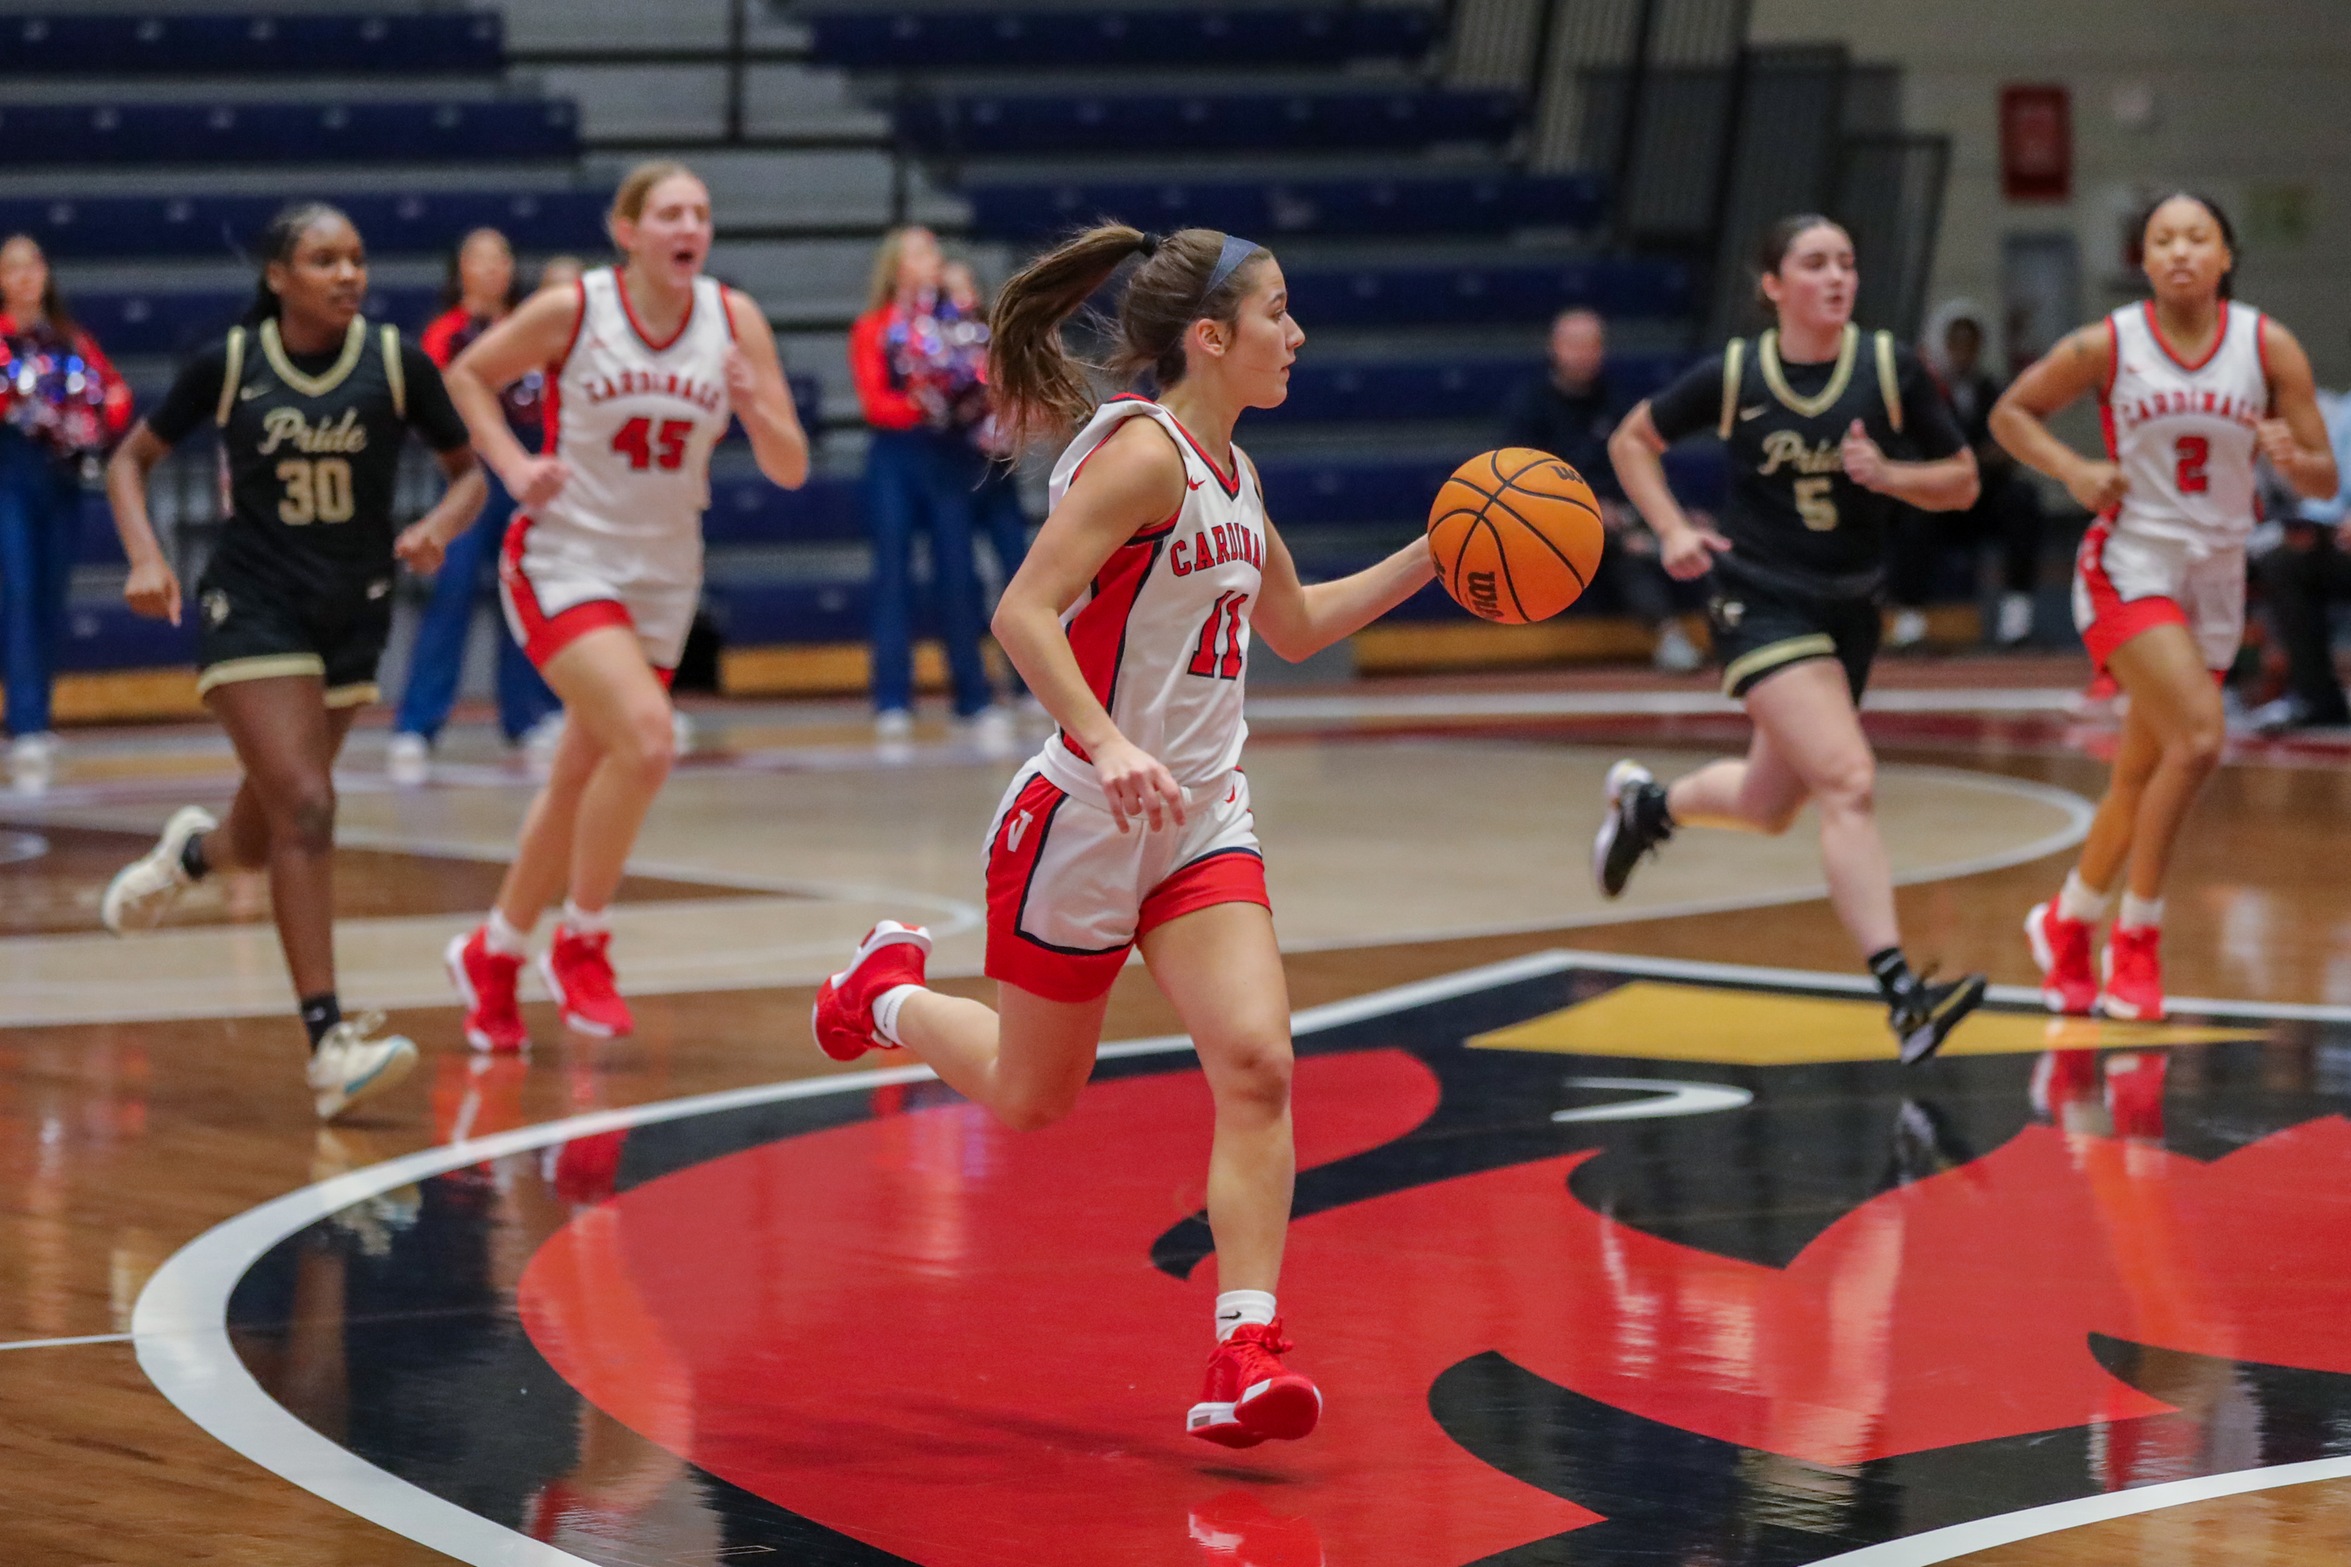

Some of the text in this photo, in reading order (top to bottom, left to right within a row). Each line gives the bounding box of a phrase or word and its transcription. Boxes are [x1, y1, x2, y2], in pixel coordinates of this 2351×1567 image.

[258, 406, 368, 455] Pride
[612, 416, 694, 472] 45
[276, 459, 354, 526] 30
[2175, 434, 2210, 495] 2
[1793, 478, 1839, 532] 5
[1170, 523, 1265, 577] CARDINA
[1187, 590, 1249, 680] 11
